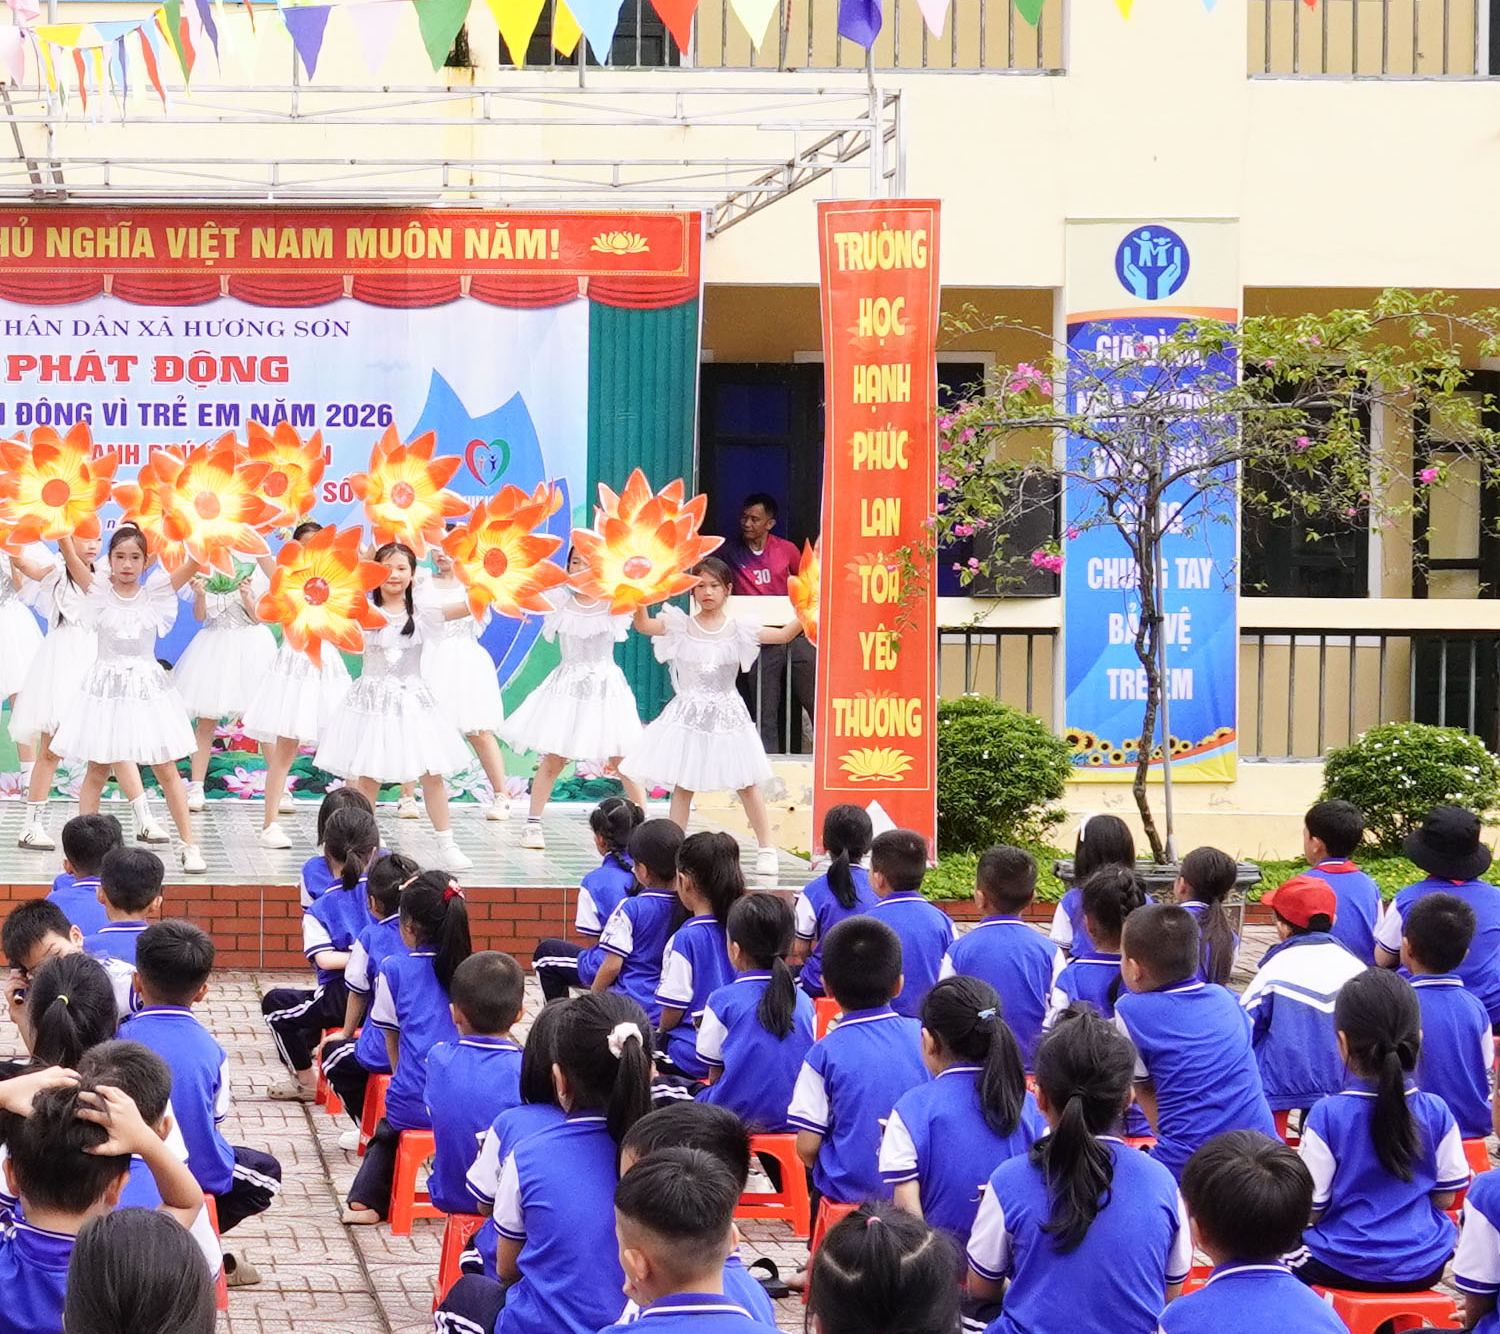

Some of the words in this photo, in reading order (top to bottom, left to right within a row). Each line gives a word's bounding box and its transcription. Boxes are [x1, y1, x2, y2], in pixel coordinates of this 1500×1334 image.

[46, 222, 155, 258] NGHĨA
[167, 221, 240, 266] VIỆT
[251, 228, 334, 259] NAM
[346, 221, 452, 260] MUÔN
[464, 221, 560, 260] NĂM!
[834, 223, 928, 271] TRƯỜNG
[72, 314, 129, 337] DÂN
[138, 315, 173, 337] XÃ
[183, 318, 286, 339] HƯƠNG
[294, 318, 351, 338] SƠN
[859, 297, 906, 349] HỌC
[6, 348, 139, 383] PHÁT
[152, 349, 290, 389] ĐỘNG
[853, 363, 911, 412] HẠNH
[103, 399, 127, 427] VÌ
[138, 395, 187, 427] TRẺ
[198, 403, 240, 427] EM
[250, 398, 316, 427] NĂM
[326, 403, 392, 428] 2026
[852, 429, 909, 471] PHÚC
[860, 497, 901, 537] LAN
[753, 569, 770, 584] 30
[859, 550, 899, 604] TỎA
[1174, 557, 1213, 589] TAY
[859, 623, 899, 671] YÊU
[832, 697, 922, 738] THƯƠNG
